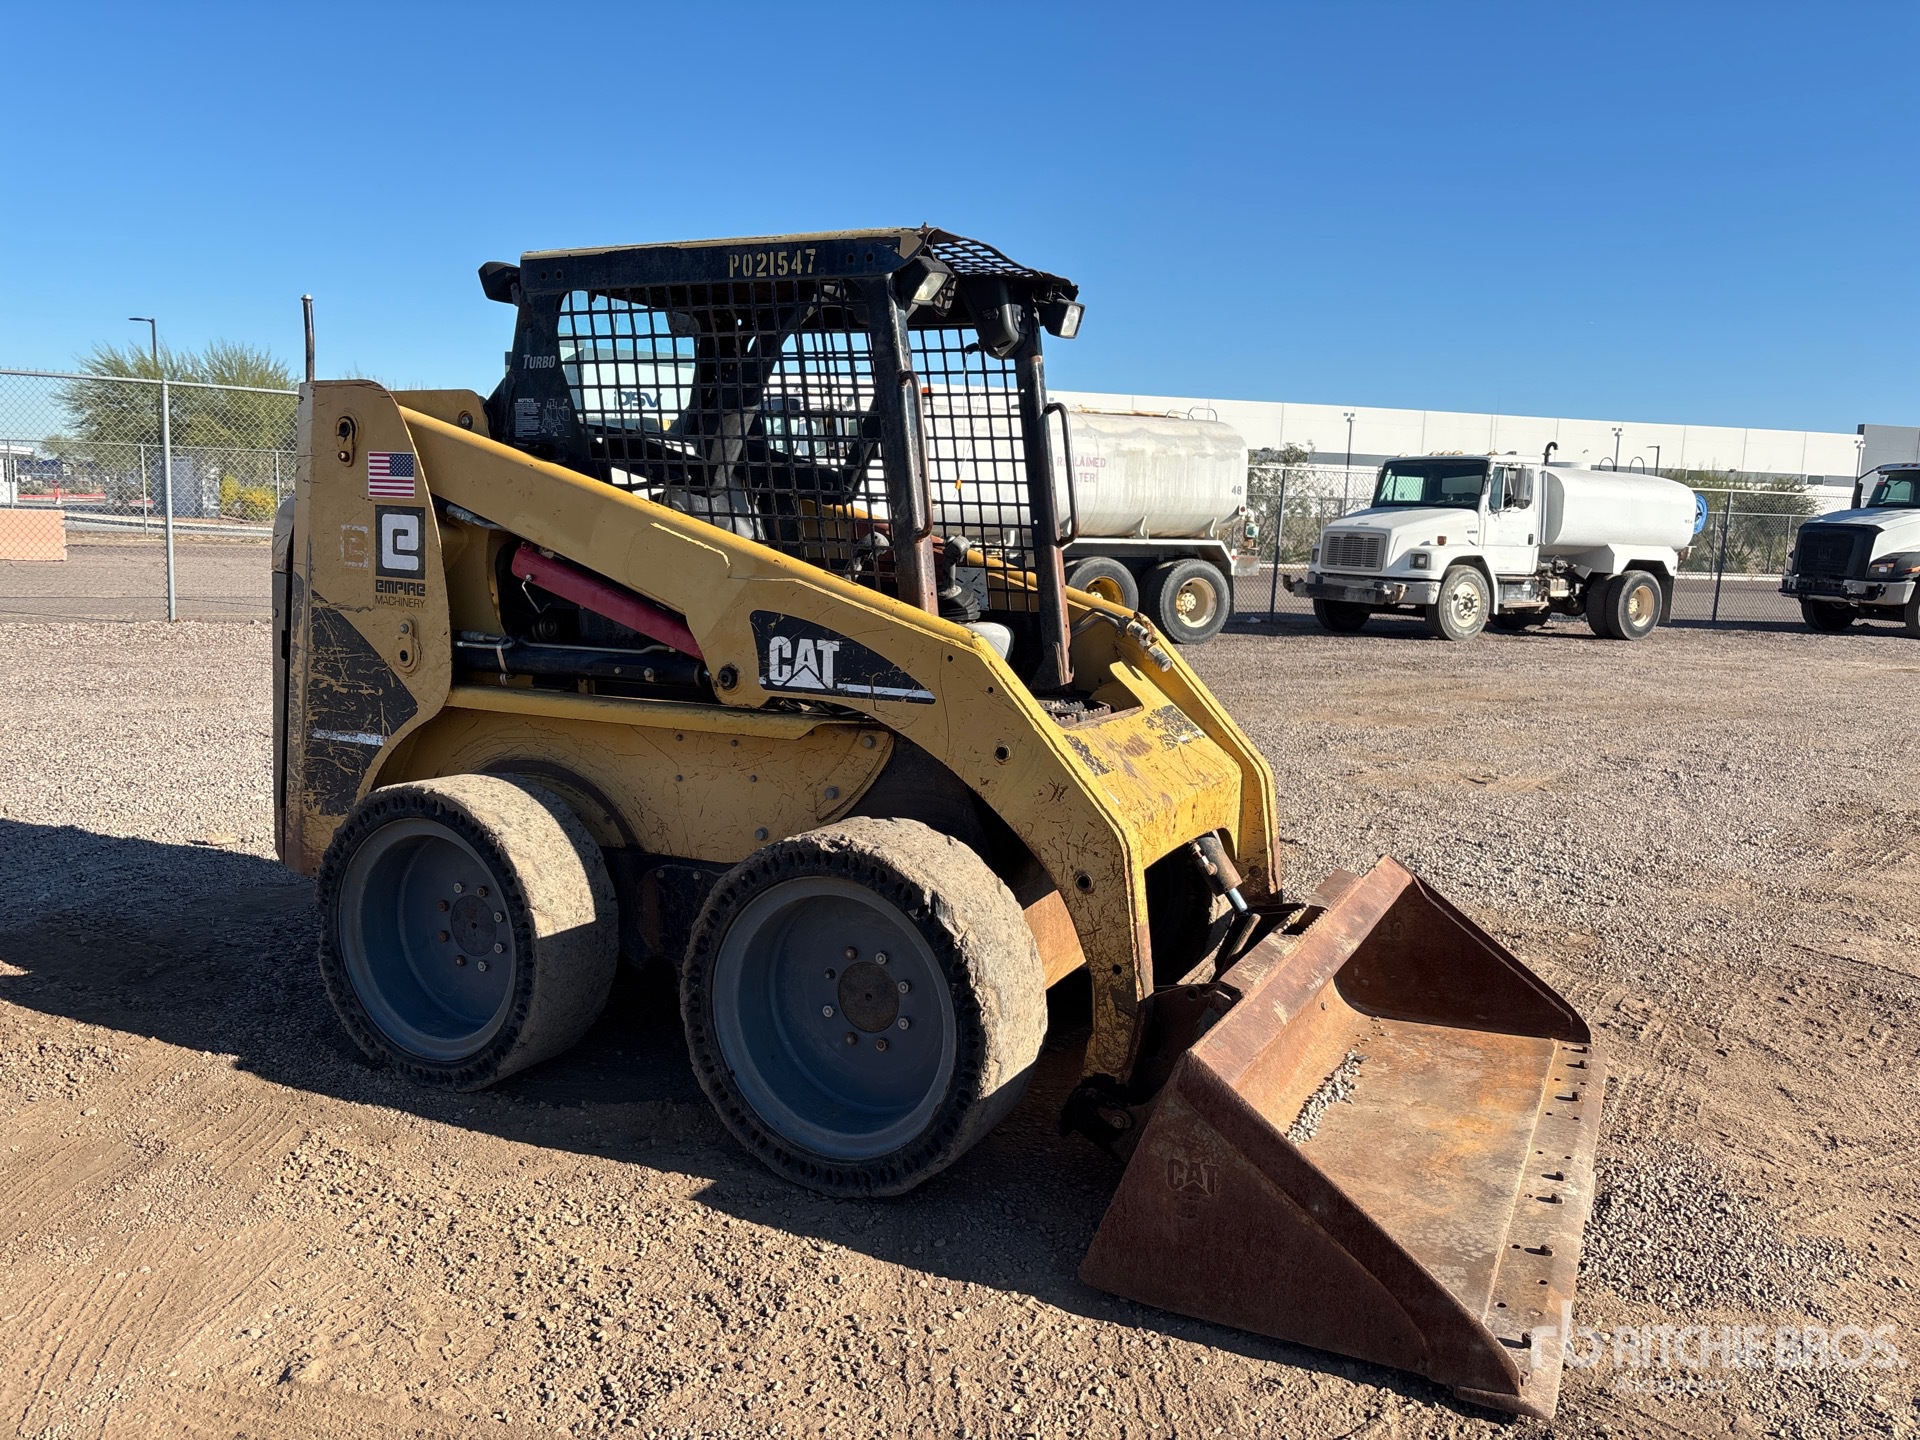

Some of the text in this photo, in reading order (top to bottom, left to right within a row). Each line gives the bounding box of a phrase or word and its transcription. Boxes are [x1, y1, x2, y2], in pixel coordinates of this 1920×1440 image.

[729, 248, 816, 278] P021547
[523, 354, 556, 370] TURBO
[1056, 456, 1106, 469] RLAIMED
[1231, 485, 1242, 495] 48
[375, 595, 426, 609] MACHINERY
[769, 636, 840, 690] CAT
[1166, 1158, 1221, 1197] CAT
